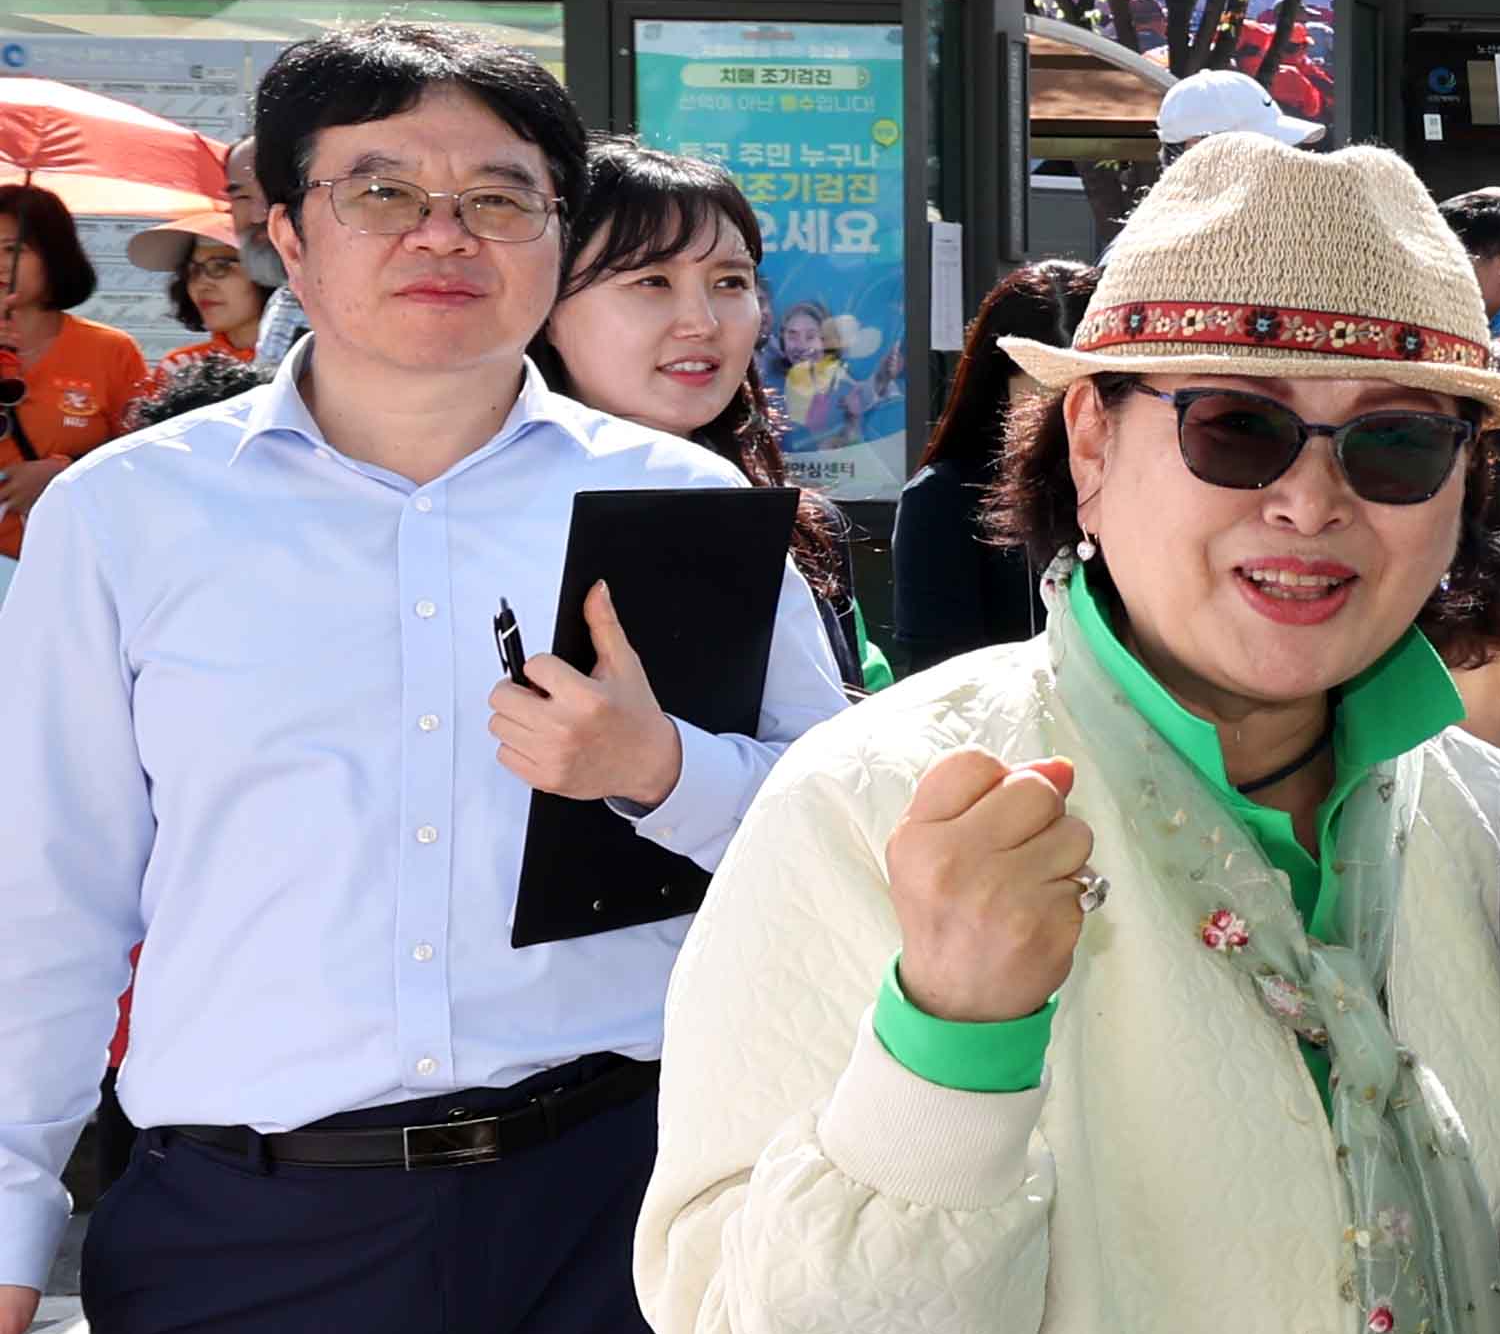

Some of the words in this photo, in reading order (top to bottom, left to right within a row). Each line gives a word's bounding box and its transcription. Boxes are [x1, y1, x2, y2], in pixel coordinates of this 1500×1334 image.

[720, 68, 755, 85] 치매
[760, 68, 832, 86] 조기검진
[739, 143, 791, 168] 주민
[800, 142, 880, 169] 누구나
[738, 173, 880, 204] 조기검진
[784, 462, 856, 480] 안심센터
